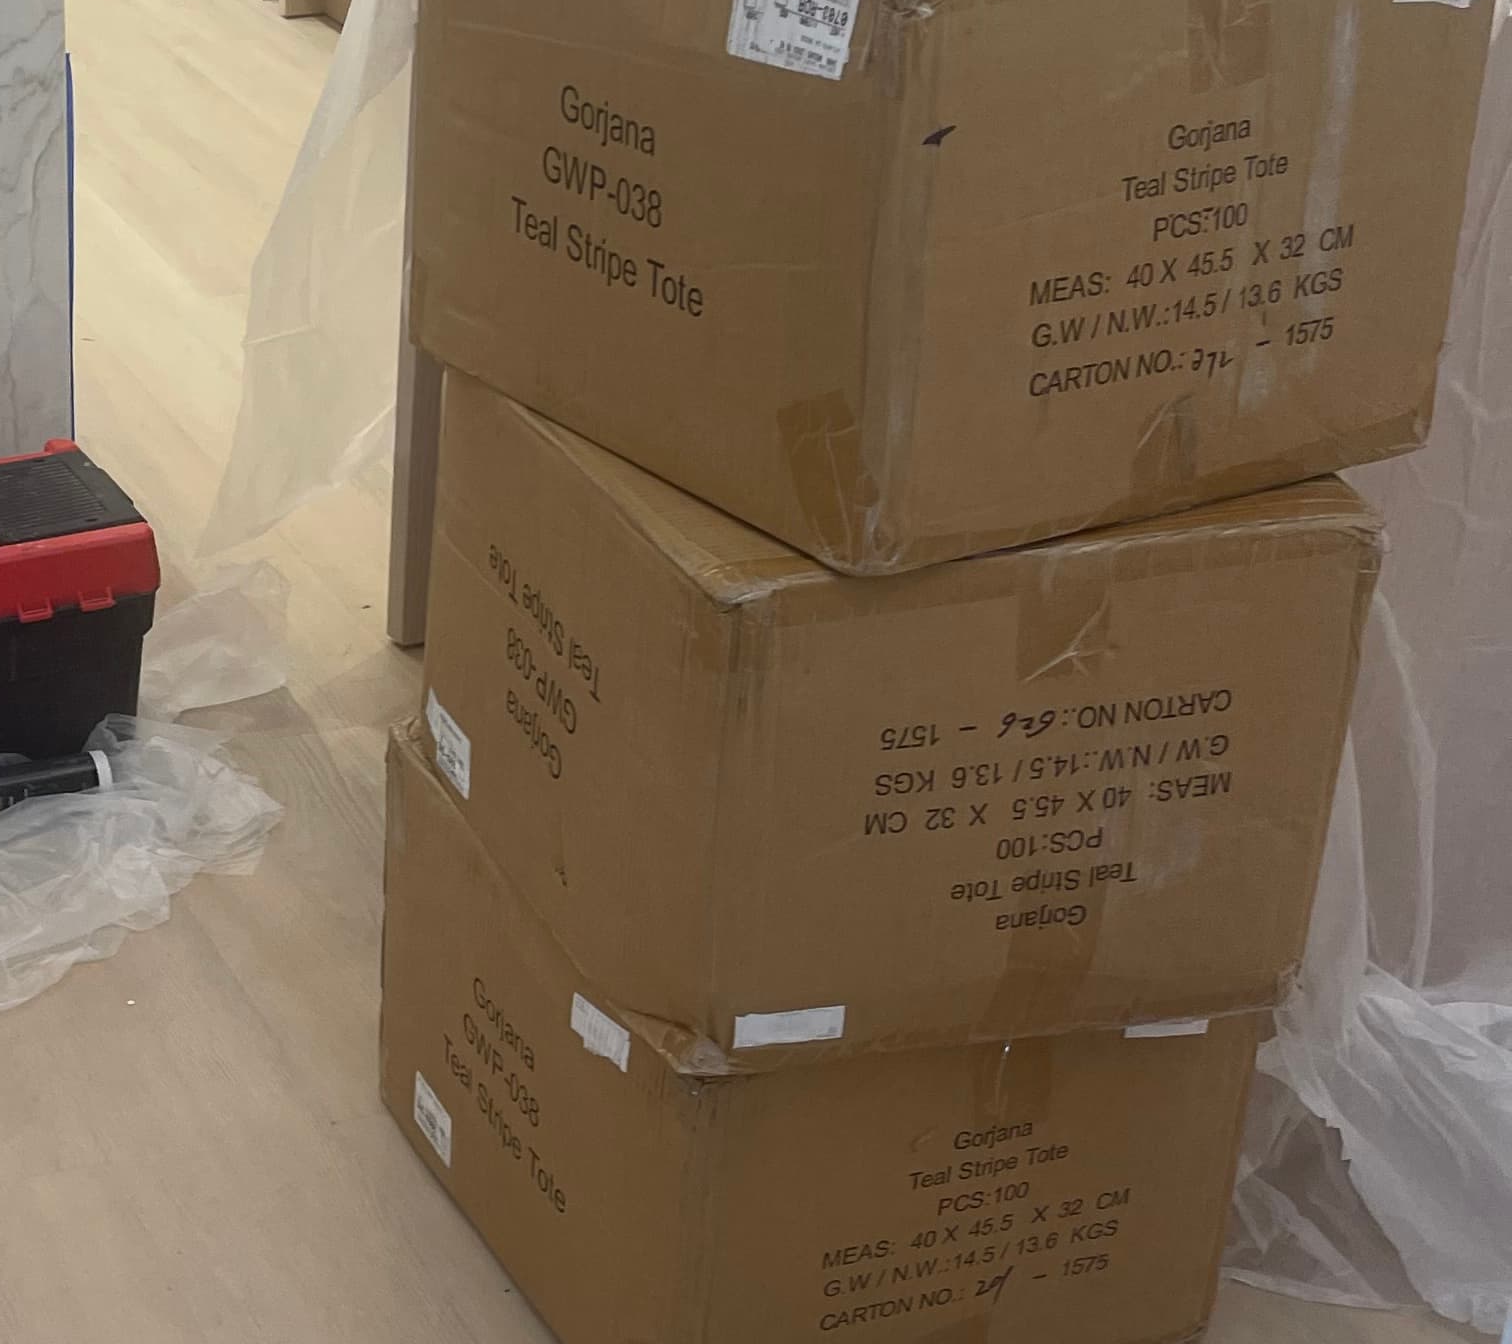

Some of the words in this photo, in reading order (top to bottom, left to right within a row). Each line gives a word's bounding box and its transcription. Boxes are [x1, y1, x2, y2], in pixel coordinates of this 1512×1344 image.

[561, 85, 655, 156] Gorjana
[1168, 119, 1251, 152] Gorjana
[543, 146, 662, 228] GWP-038
[1122, 171, 1165, 202] Teal
[1174, 161, 1237, 194] Stripe
[1243, 154, 1289, 181] Tote
[1153, 202, 1248, 242] PCS:100
[511, 196, 558, 251] Teal
[567, 224, 637, 286] Stripe
[647, 258, 704, 317] Tote
[1029, 272, 1111, 306] MEAS:
[1126, 262, 1154, 289] 40
[1159, 258, 1178, 284] X
[1186, 247, 1234, 277] 45.5
[1252, 239, 1272, 267] X
[1280, 233, 1307, 261] 32
[1318, 224, 1355, 254] CM
[1293, 268, 1343, 299] KGS
[1029, 356, 1130, 398] CARTON
[1285, 317, 1335, 346] 1575
[1126, 689, 1232, 721] CARTON
[880, 723, 941, 751] 1575
[874, 768, 936, 796] KGS
[1102, 784, 1133, 809] 40
[1148, 772, 1232, 802] MEAS:
[968, 802, 989, 826] X
[1012, 794, 1066, 821] 45.5
[1076, 789, 1097, 813] X
[863, 810, 908, 836] CM
[925, 806, 956, 831] 32
[996, 826, 1103, 860] PCS:100
[1011, 865, 1081, 894] Stripe
[1088, 861, 1137, 887] Teal
[950, 880, 1002, 903] Tote
[995, 903, 1087, 931] Gorjana
[953, 1121, 1033, 1150] Gorjana
[909, 1166, 952, 1191] Teal
[958, 1154, 1018, 1181] Stripe
[1025, 1144, 1070, 1166] Tote
[937, 1181, 1029, 1216] PCS:100
[821, 1239, 896, 1271] MEAS:
[910, 1230, 937, 1251] 40
[941, 1226, 960, 1245] X
[968, 1214, 1014, 1238] 45.5
[1030, 1207, 1049, 1224] X
[1057, 1199, 1083, 1219] 32
[1095, 1187, 1132, 1211] CM
[1070, 1219, 1119, 1245] KGS
[819, 1297, 913, 1331] CARTON
[1062, 1254, 1110, 1277] 1575
